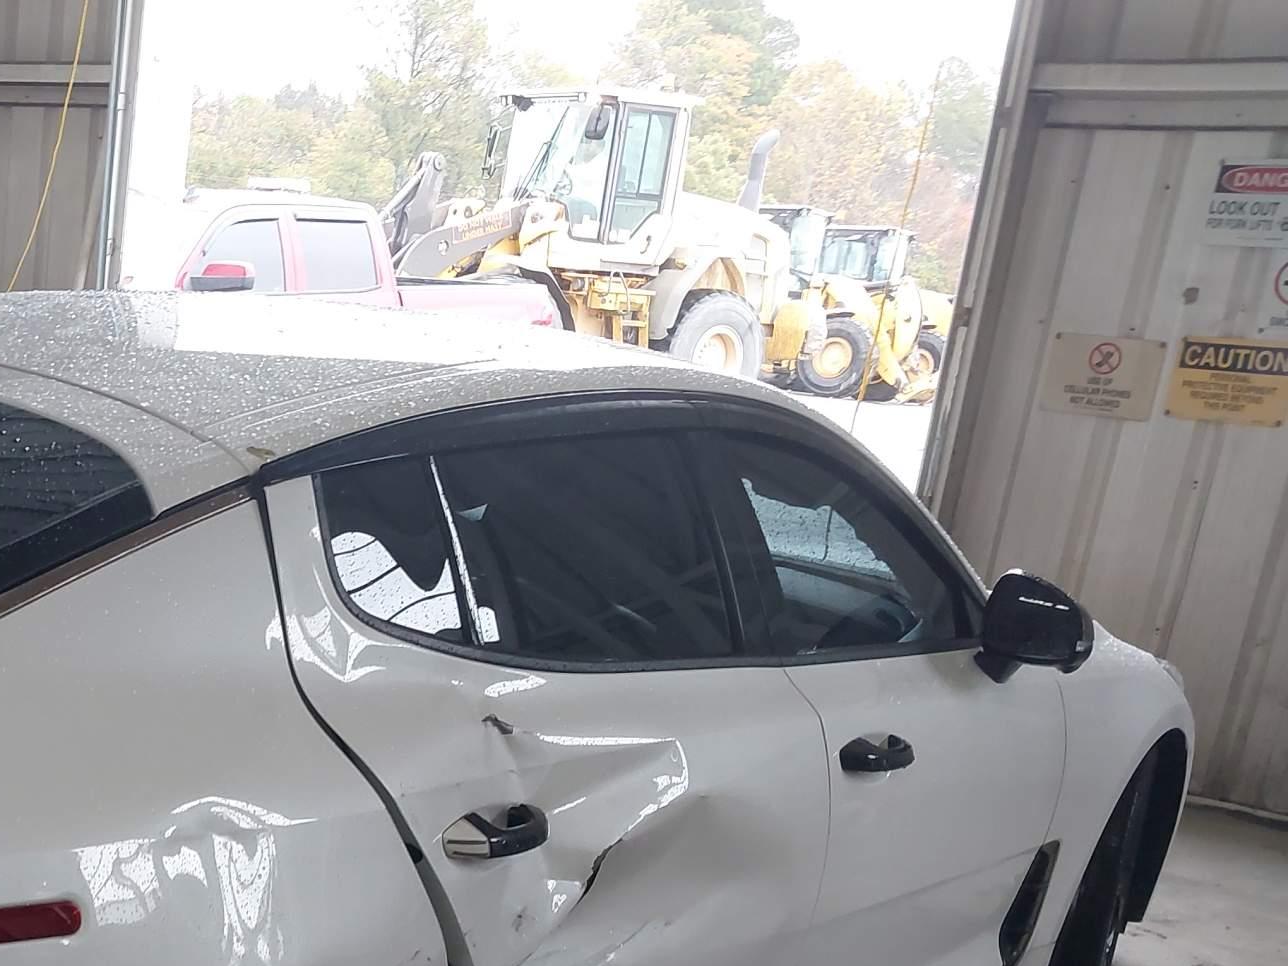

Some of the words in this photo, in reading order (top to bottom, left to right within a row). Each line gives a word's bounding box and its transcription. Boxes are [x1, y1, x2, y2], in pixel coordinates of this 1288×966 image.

[1209, 200, 1248, 215] LOOK
[1250, 201, 1280, 216] OUT
[1185, 345, 1288, 372] CAUTION
